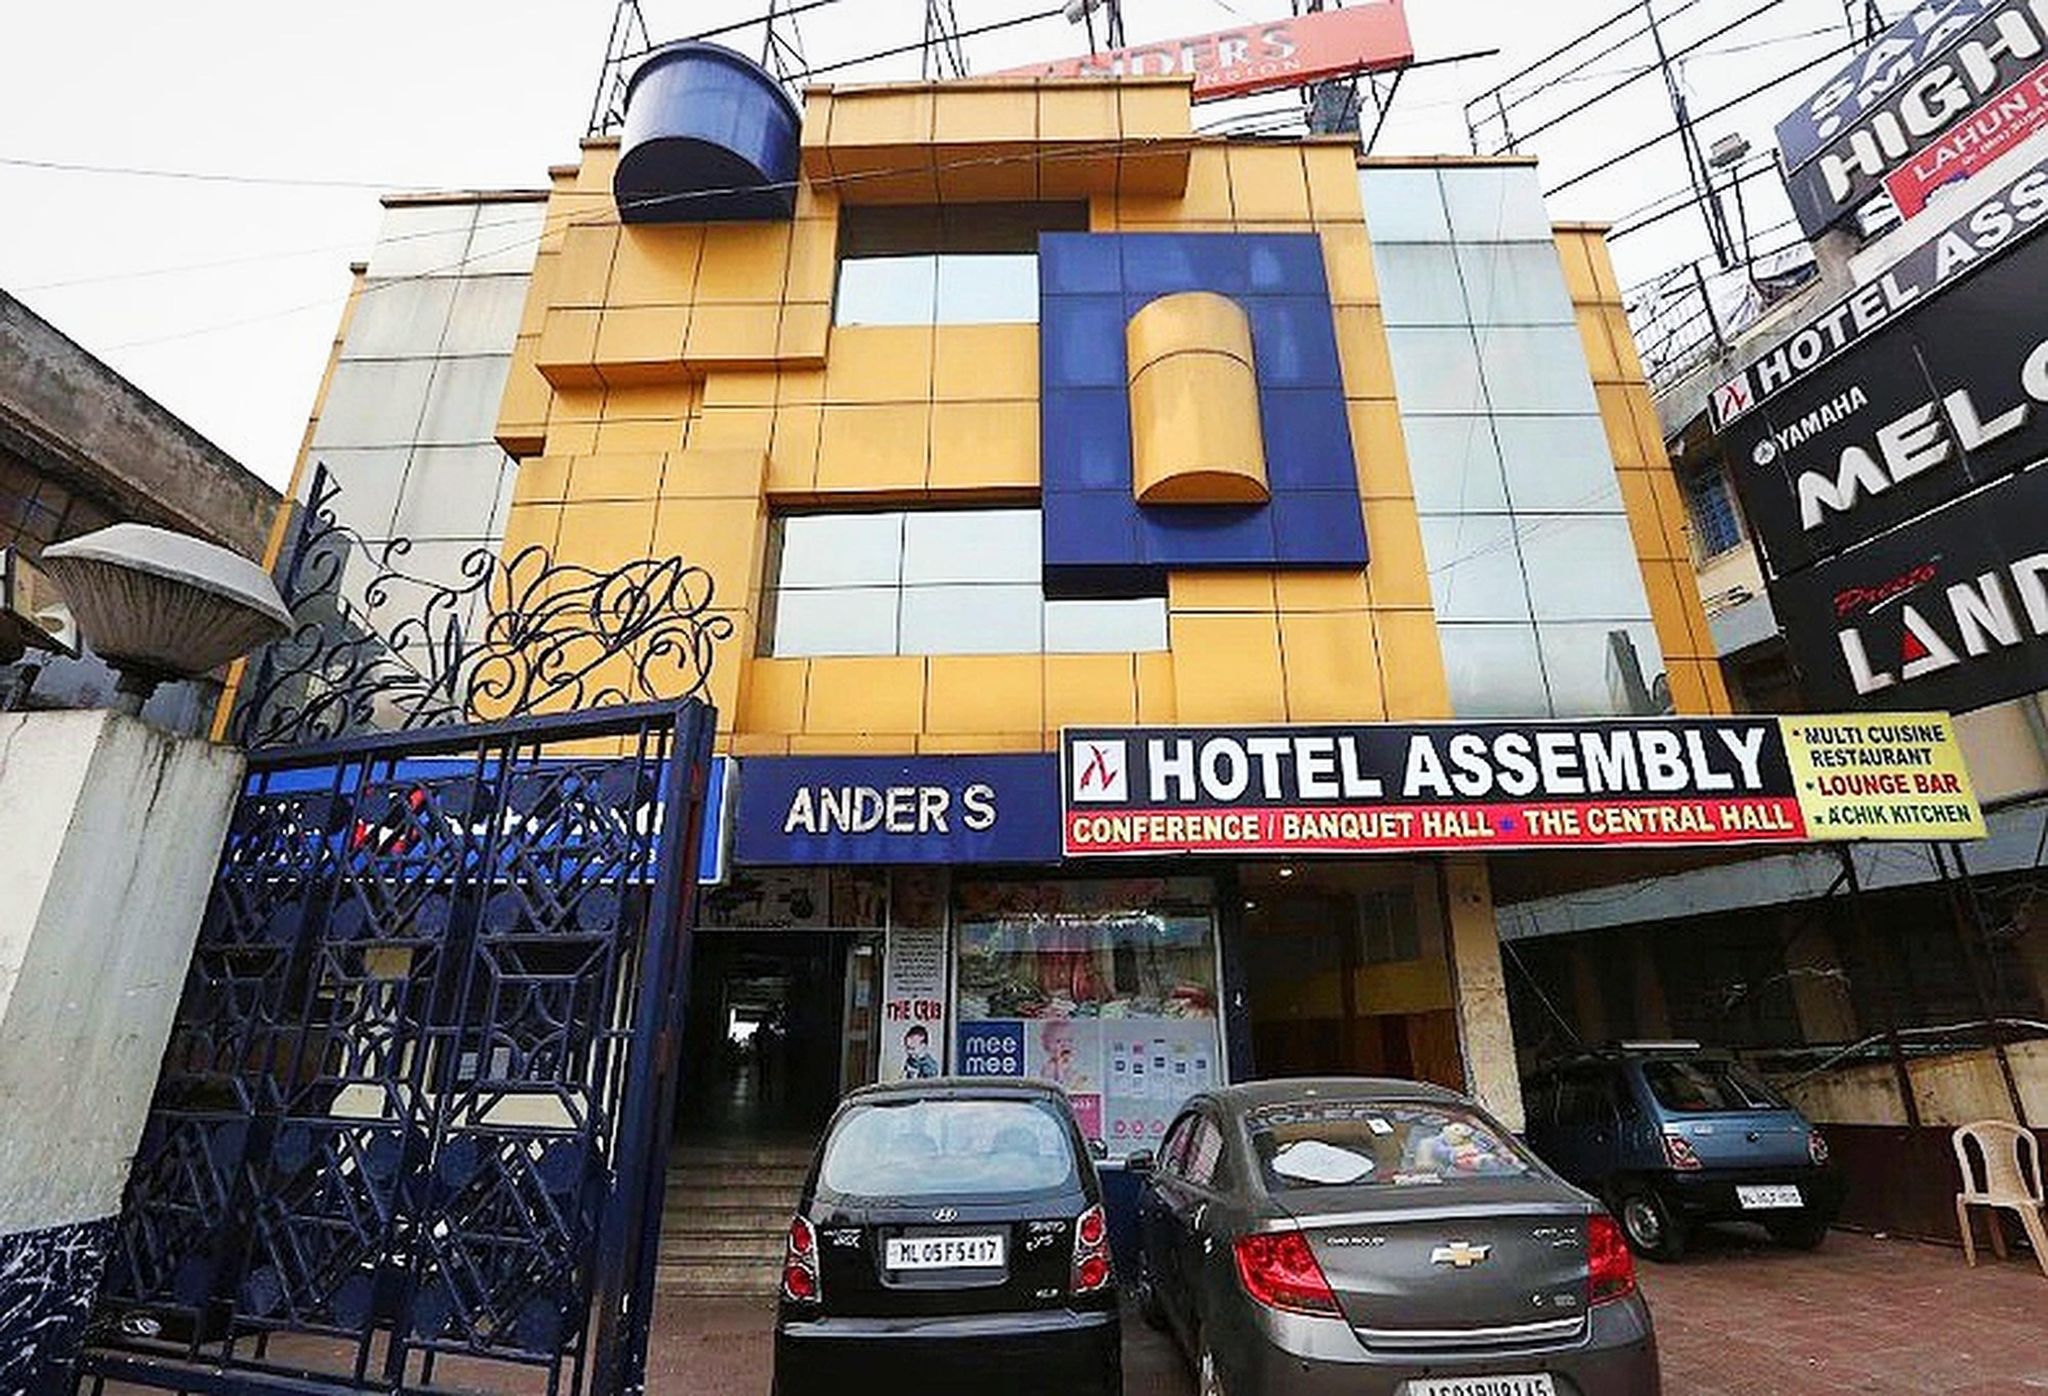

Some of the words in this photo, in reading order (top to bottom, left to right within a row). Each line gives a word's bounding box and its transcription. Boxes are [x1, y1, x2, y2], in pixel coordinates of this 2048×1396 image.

[1756, 273, 1919, 394] HOTEL
[1775, 386, 1869, 452] YAMAHA
[1805, 727, 1864, 745] MULTI
[1867, 725, 1946, 744] CUISINE
[1149, 736, 1383, 801] HOTEL
[1403, 727, 1766, 798] ASSEMBLY
[1811, 749, 1933, 768] RESTAURANT
[1818, 774, 1911, 796] LOUNGE
[1914, 773, 1962, 795] BAR
[1073, 812, 1260, 843] CONFERENCE
[1283, 811, 1413, 840] BANQUET
[1421, 810, 1494, 838] HALL
[1523, 809, 1581, 836] THE
[1589, 807, 1716, 834] CENTRAL
[1724, 805, 1795, 831] HALL
[1889, 804, 1972, 824] KITCHEN
[887, 1001, 911, 1021] THE
[965, 1036, 1017, 1055] mee
[965, 1055, 1017, 1075] mee
